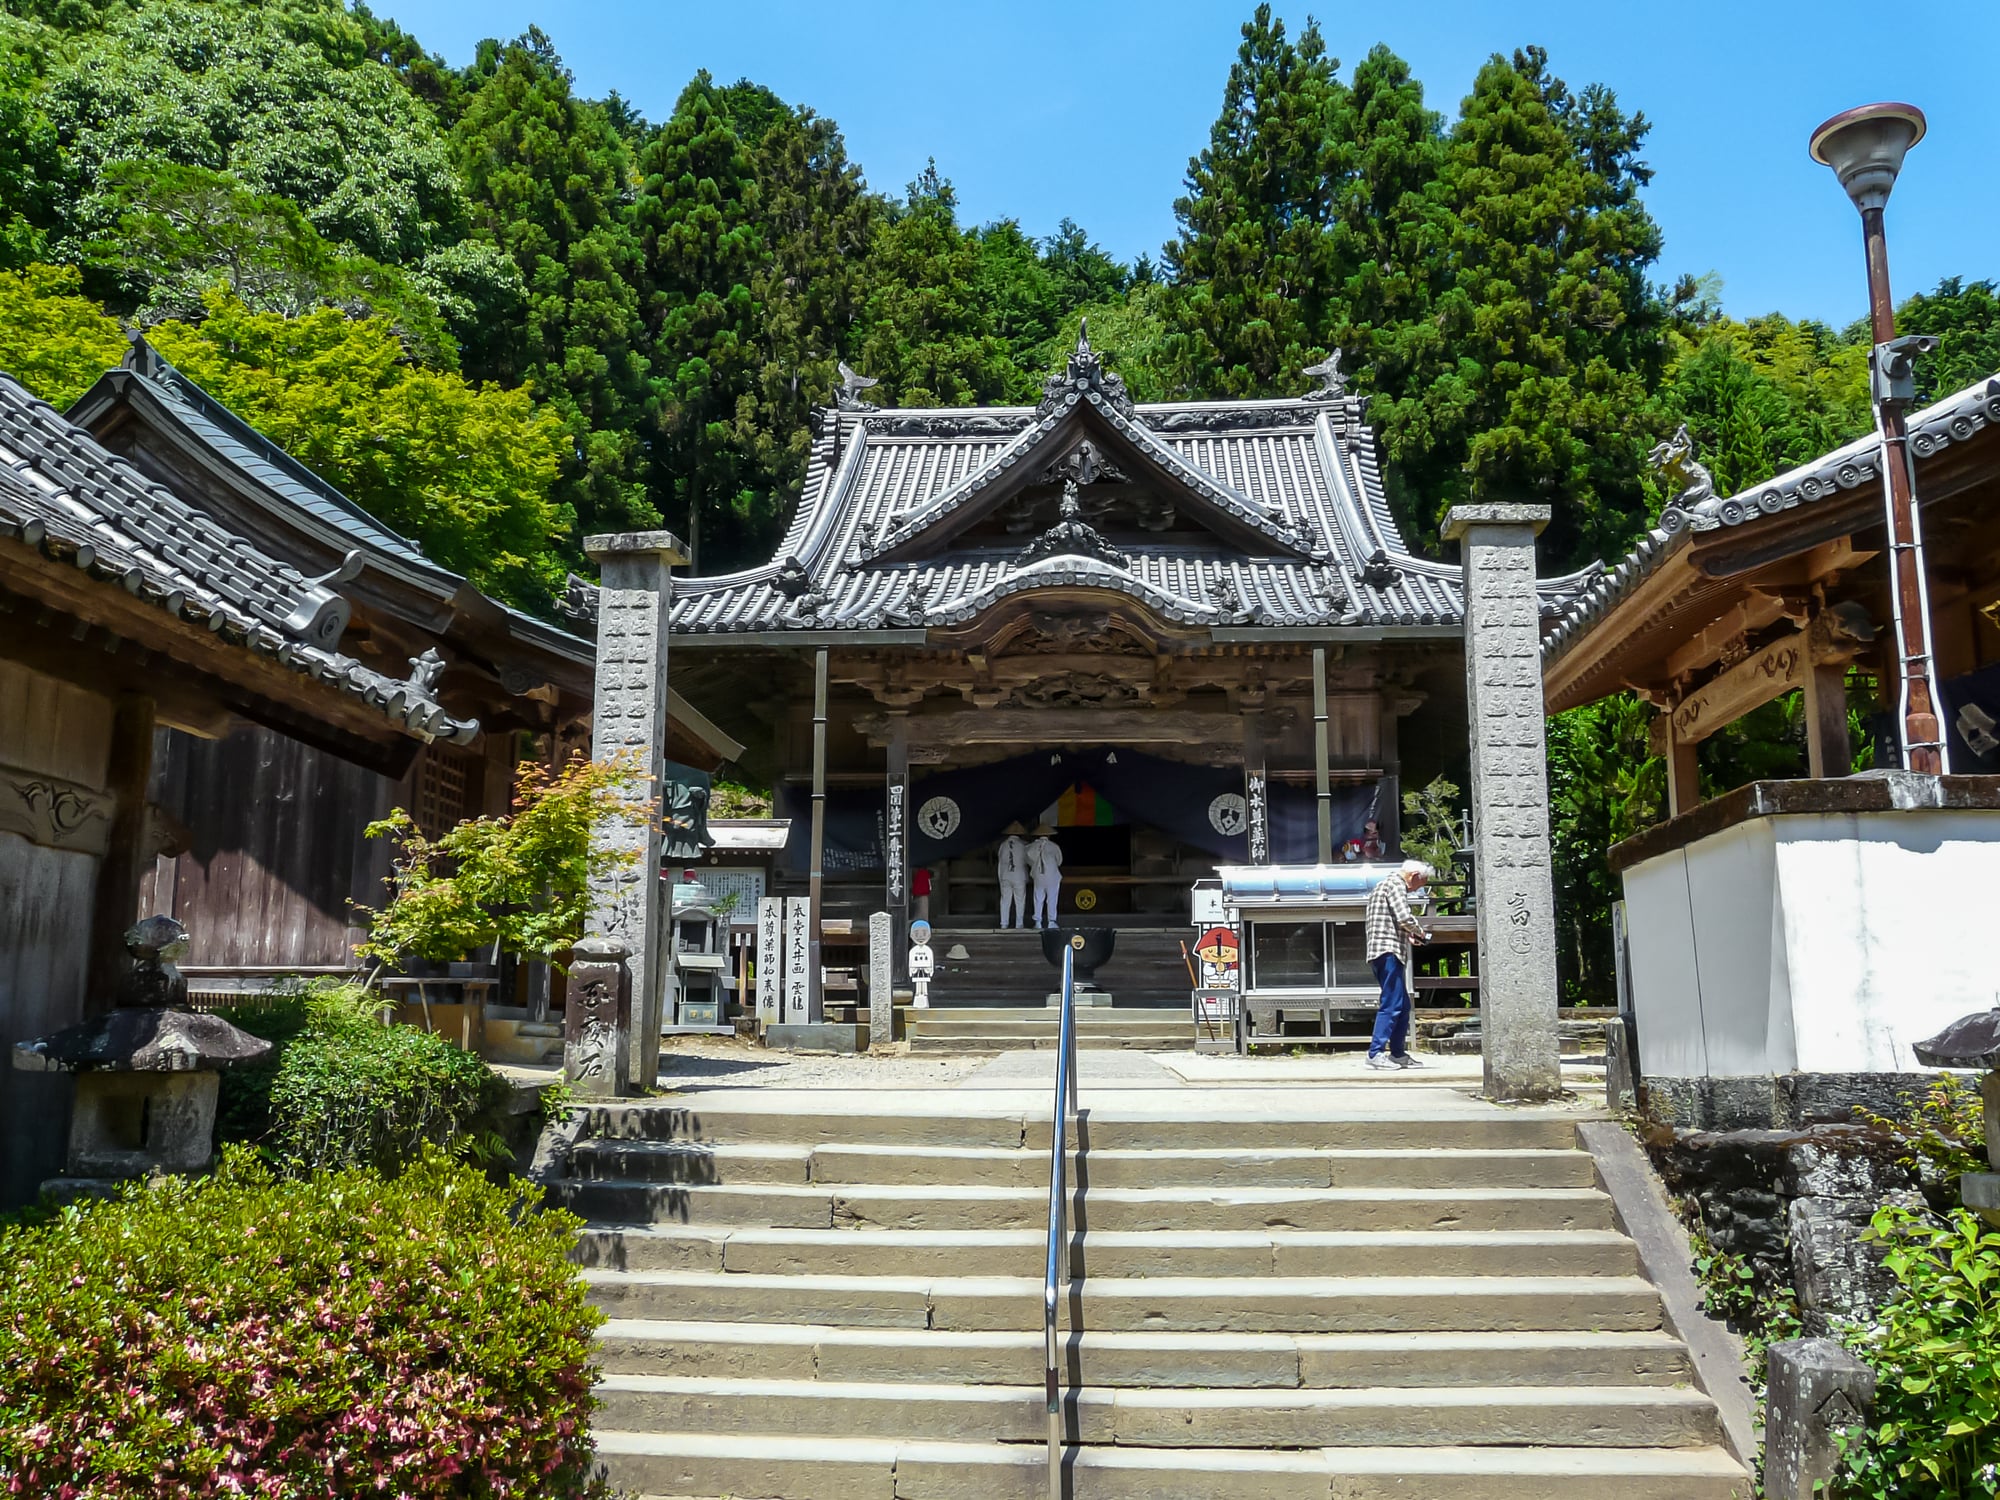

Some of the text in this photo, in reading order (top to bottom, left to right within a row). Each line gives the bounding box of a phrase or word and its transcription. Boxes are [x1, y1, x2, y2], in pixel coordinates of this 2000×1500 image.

[763, 904, 778, 1009] 本尊薬師如来像
[791, 903, 806, 974] 本堂天井画
